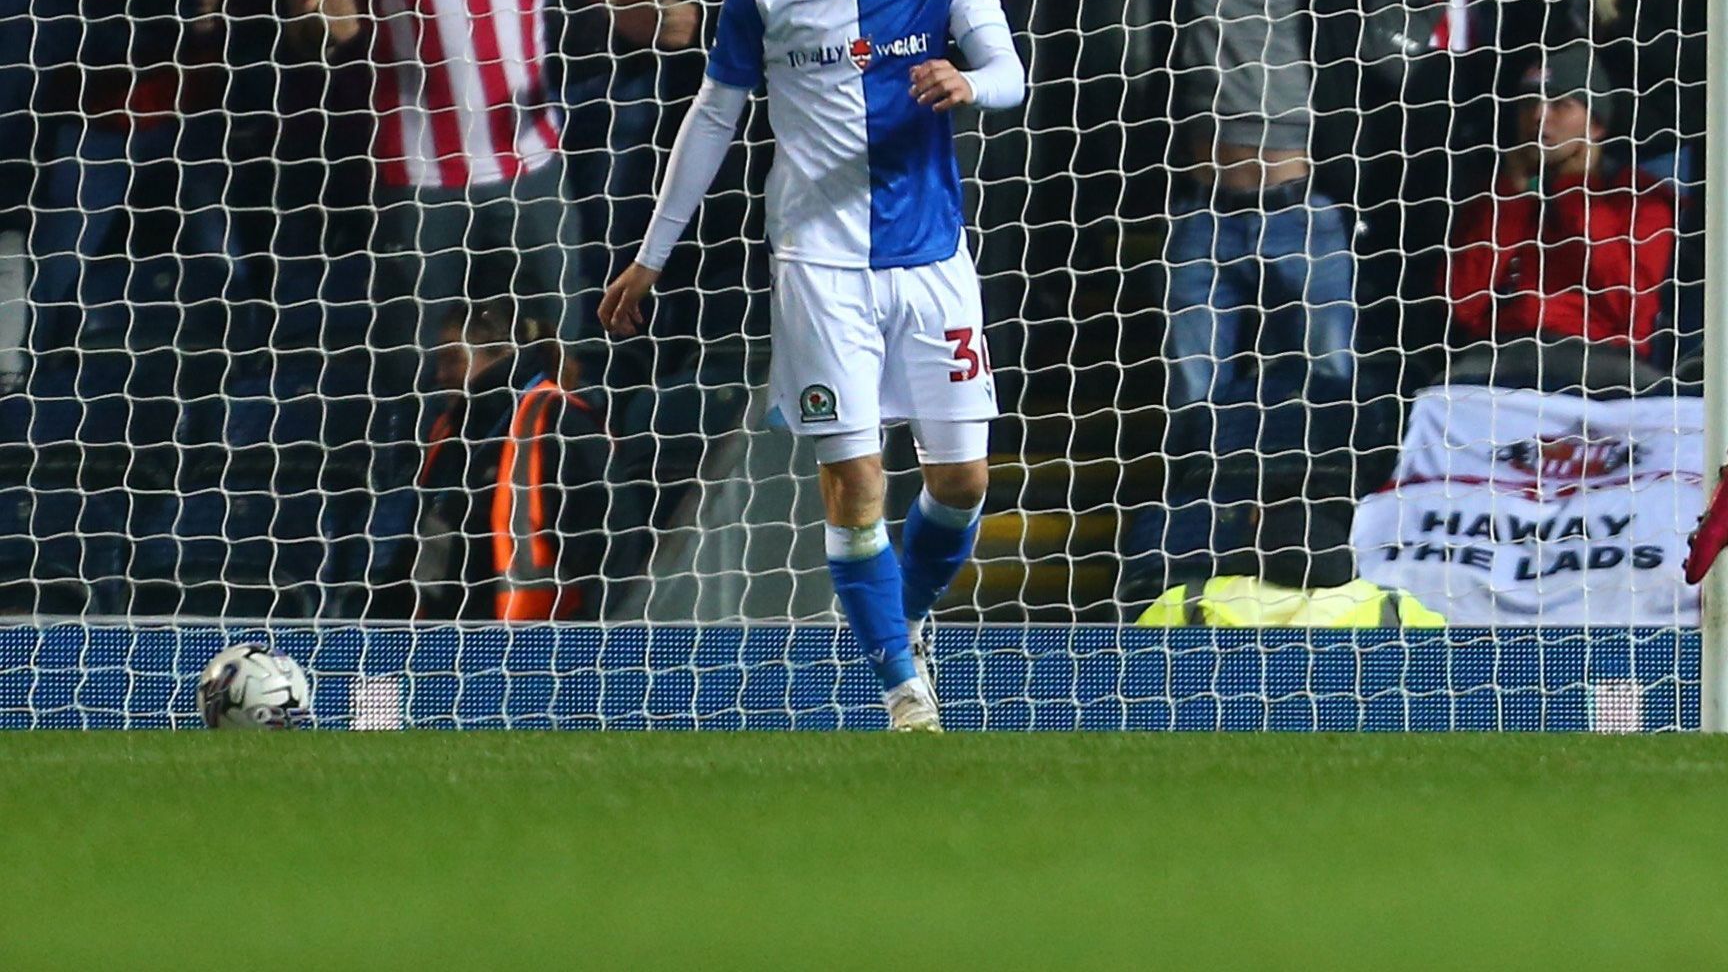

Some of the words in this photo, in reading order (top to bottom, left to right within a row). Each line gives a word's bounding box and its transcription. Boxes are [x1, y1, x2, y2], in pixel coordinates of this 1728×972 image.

[944, 326, 990, 383] 3
[1421, 511, 1637, 542] HAWAY
[1386, 540, 1494, 571] THE
[1513, 545, 1664, 581] LADS
